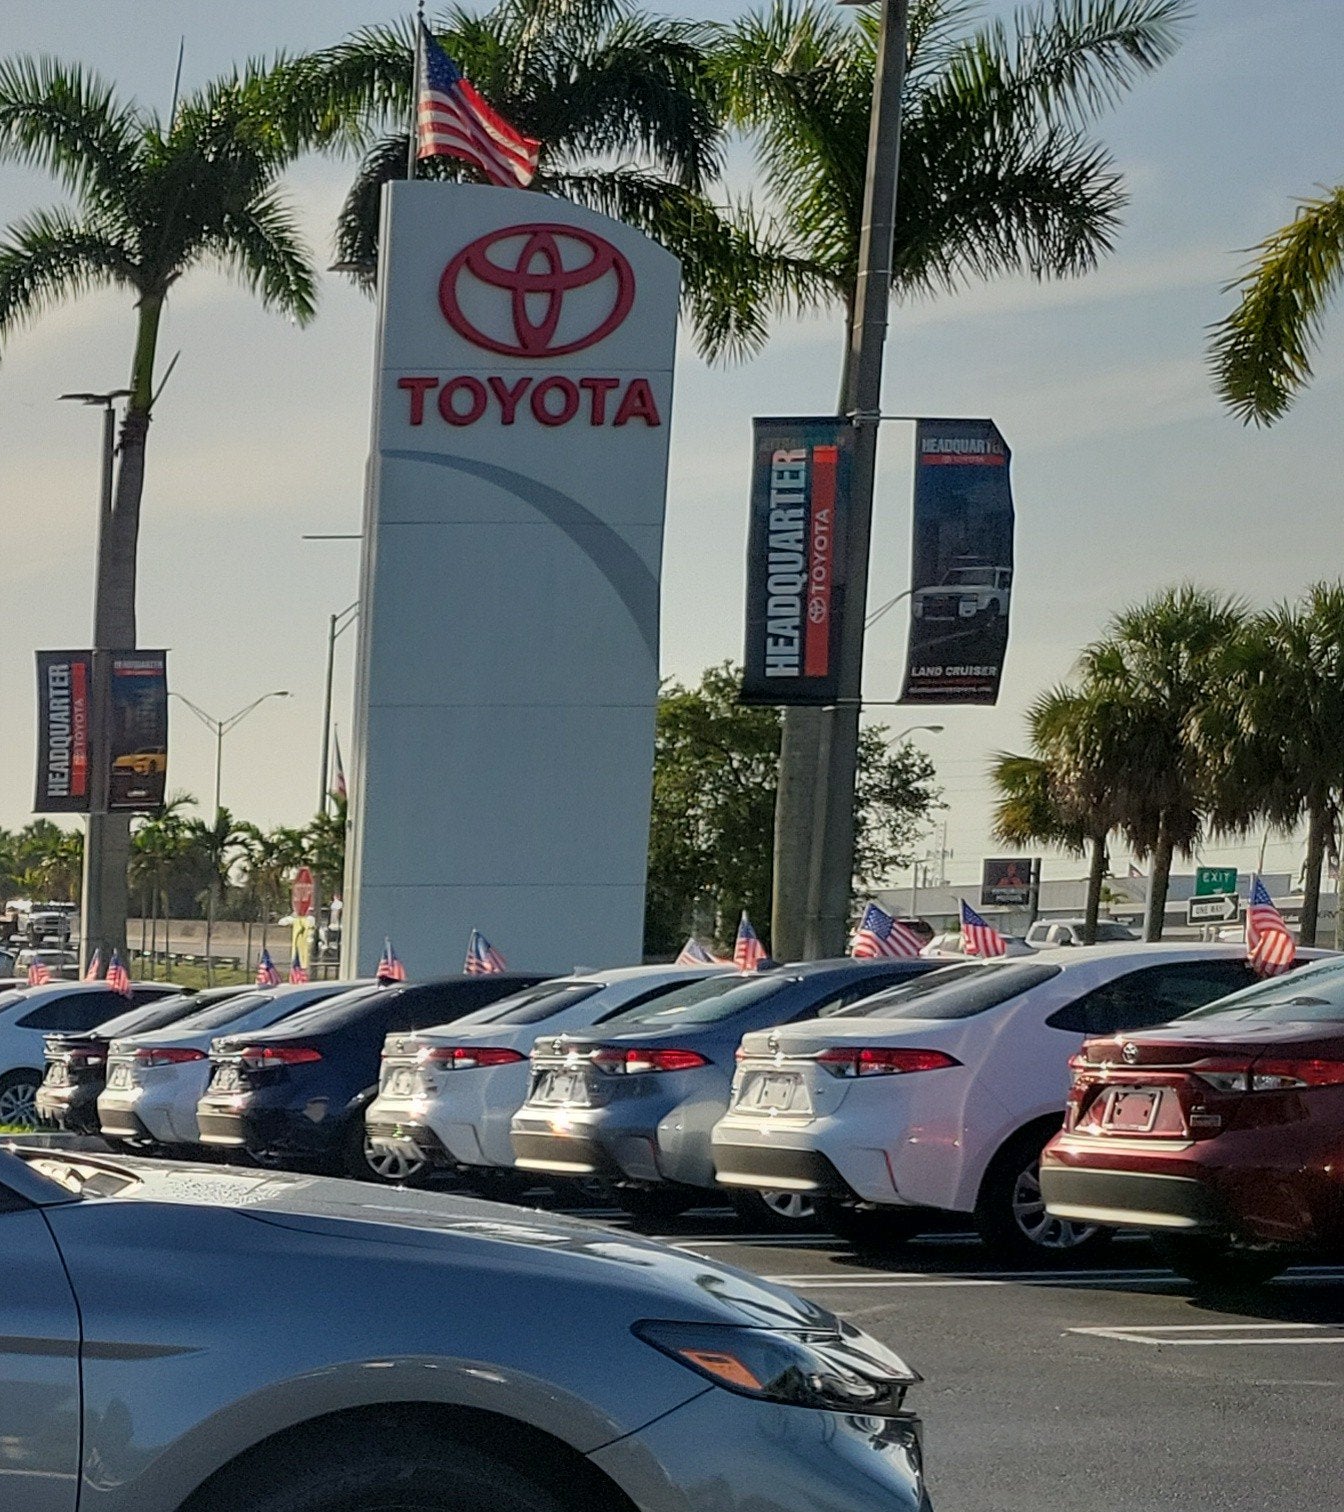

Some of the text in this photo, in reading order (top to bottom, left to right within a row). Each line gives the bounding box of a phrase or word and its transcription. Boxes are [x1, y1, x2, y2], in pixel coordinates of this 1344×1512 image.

[397, 376, 661, 427] TOYOTA
[764, 447, 808, 678] HEADQUARTER
[811, 508, 832, 595] TOYOTA
[911, 665, 998, 677] LAND CRUISER
[47, 664, 70, 797] HEADQUARTER
[73, 698, 86, 752] TOYOTA
[1202, 871, 1231, 884] EXIT
[1195, 903, 1224, 914] ONE WAY
